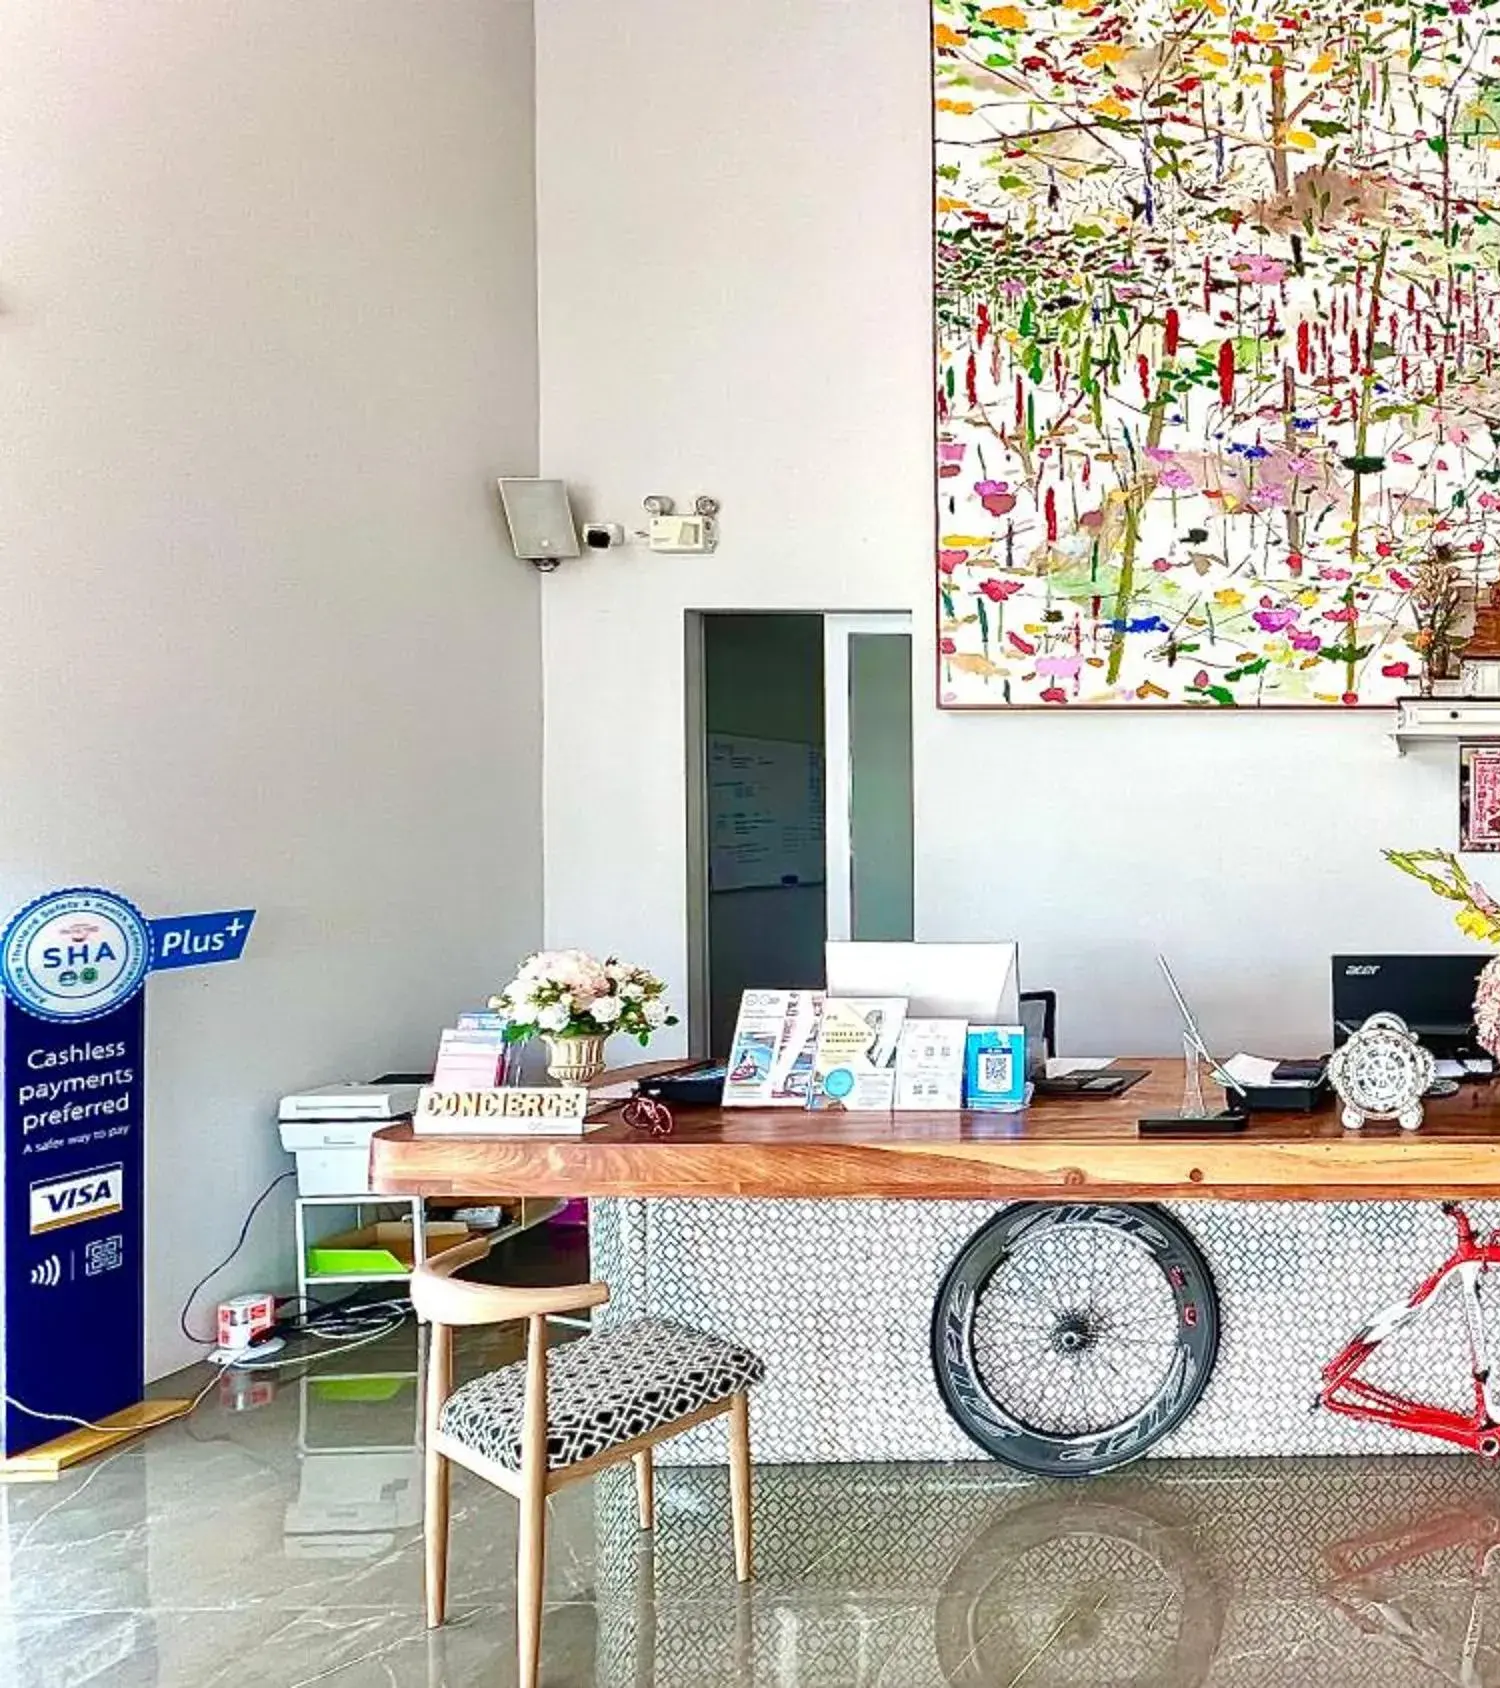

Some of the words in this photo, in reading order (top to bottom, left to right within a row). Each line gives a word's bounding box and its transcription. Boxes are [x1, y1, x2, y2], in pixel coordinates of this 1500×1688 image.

[43, 941, 117, 969] SHA
[1345, 964, 1381, 975] acer
[27, 1041, 126, 1070] Cashless
[19, 1067, 134, 1105] payments
[23, 1092, 130, 1135] preferred
[426, 1091, 580, 1117] CONCIERGE
[35, 1136, 65, 1152] safer
[42, 1179, 112, 1213] VISA
